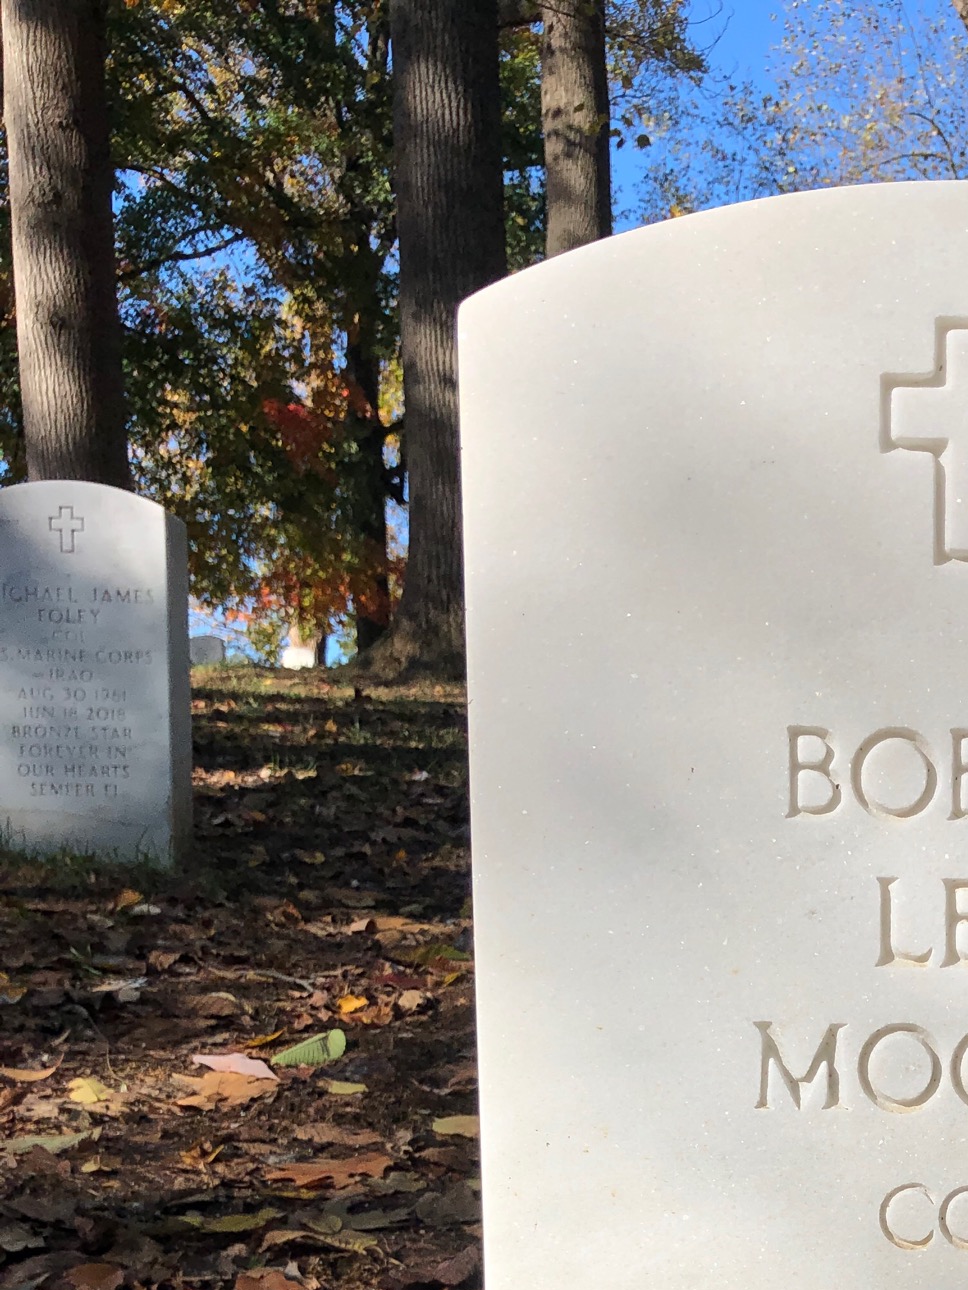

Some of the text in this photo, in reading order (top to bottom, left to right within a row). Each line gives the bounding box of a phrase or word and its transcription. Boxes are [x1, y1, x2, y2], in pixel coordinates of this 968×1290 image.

[2, 583, 77, 604] ICHAEL
[38, 608, 101, 624] FOLEY
[18, 648, 86, 663] MARINE
[95, 649, 153, 665] CORPS
[17, 687, 55, 703] AUG
[63, 687, 87, 703] 30
[11, 725, 132, 741] BRONZE STAR
[19, 744, 127, 760] FOREVER IN
[17, 763, 130, 779] OUR HEARTS
[30, 782, 95, 798] SEMPER
